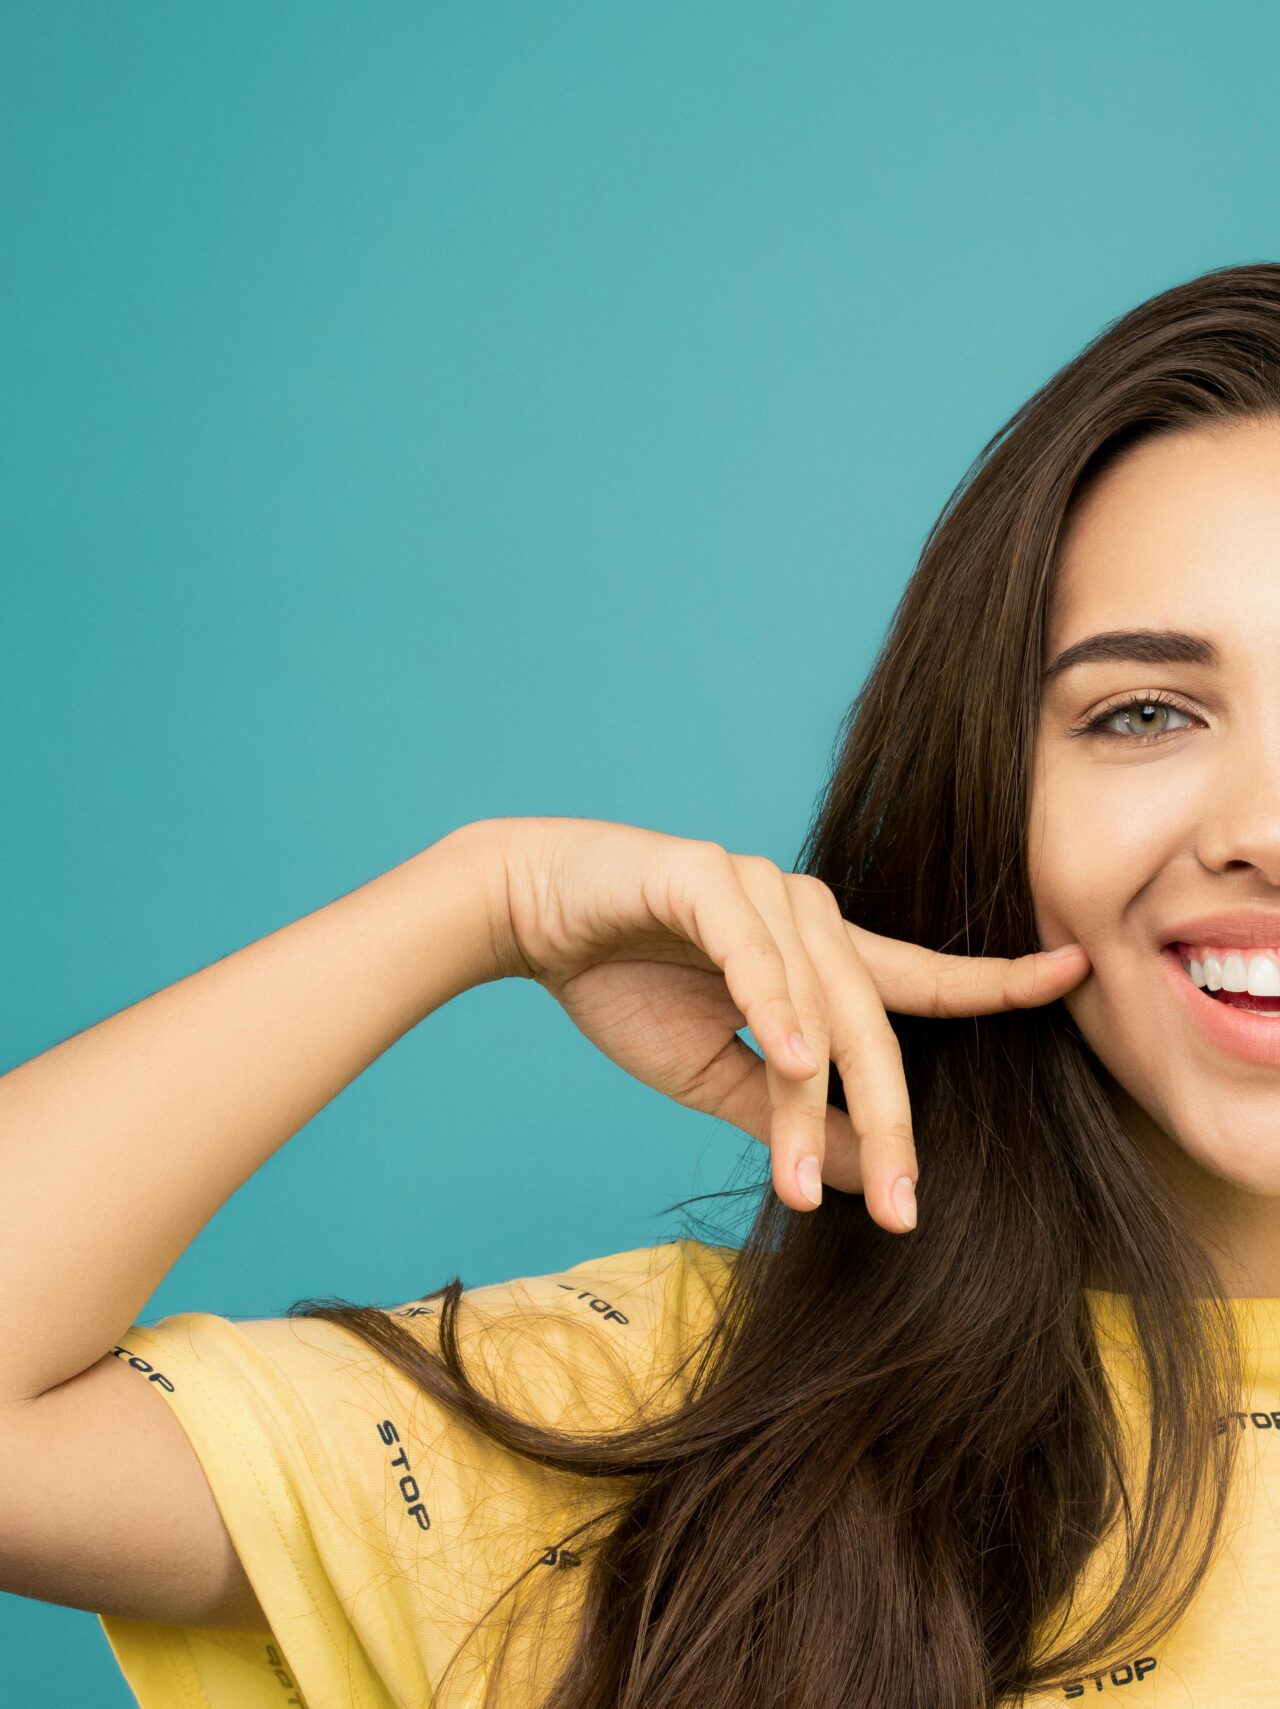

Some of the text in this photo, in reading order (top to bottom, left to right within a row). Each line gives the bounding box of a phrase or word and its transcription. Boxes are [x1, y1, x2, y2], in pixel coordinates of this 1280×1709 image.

[556, 1283, 629, 1326] TOP
[113, 1345, 175, 1393] TOP
[376, 1420, 431, 1531] STOP
